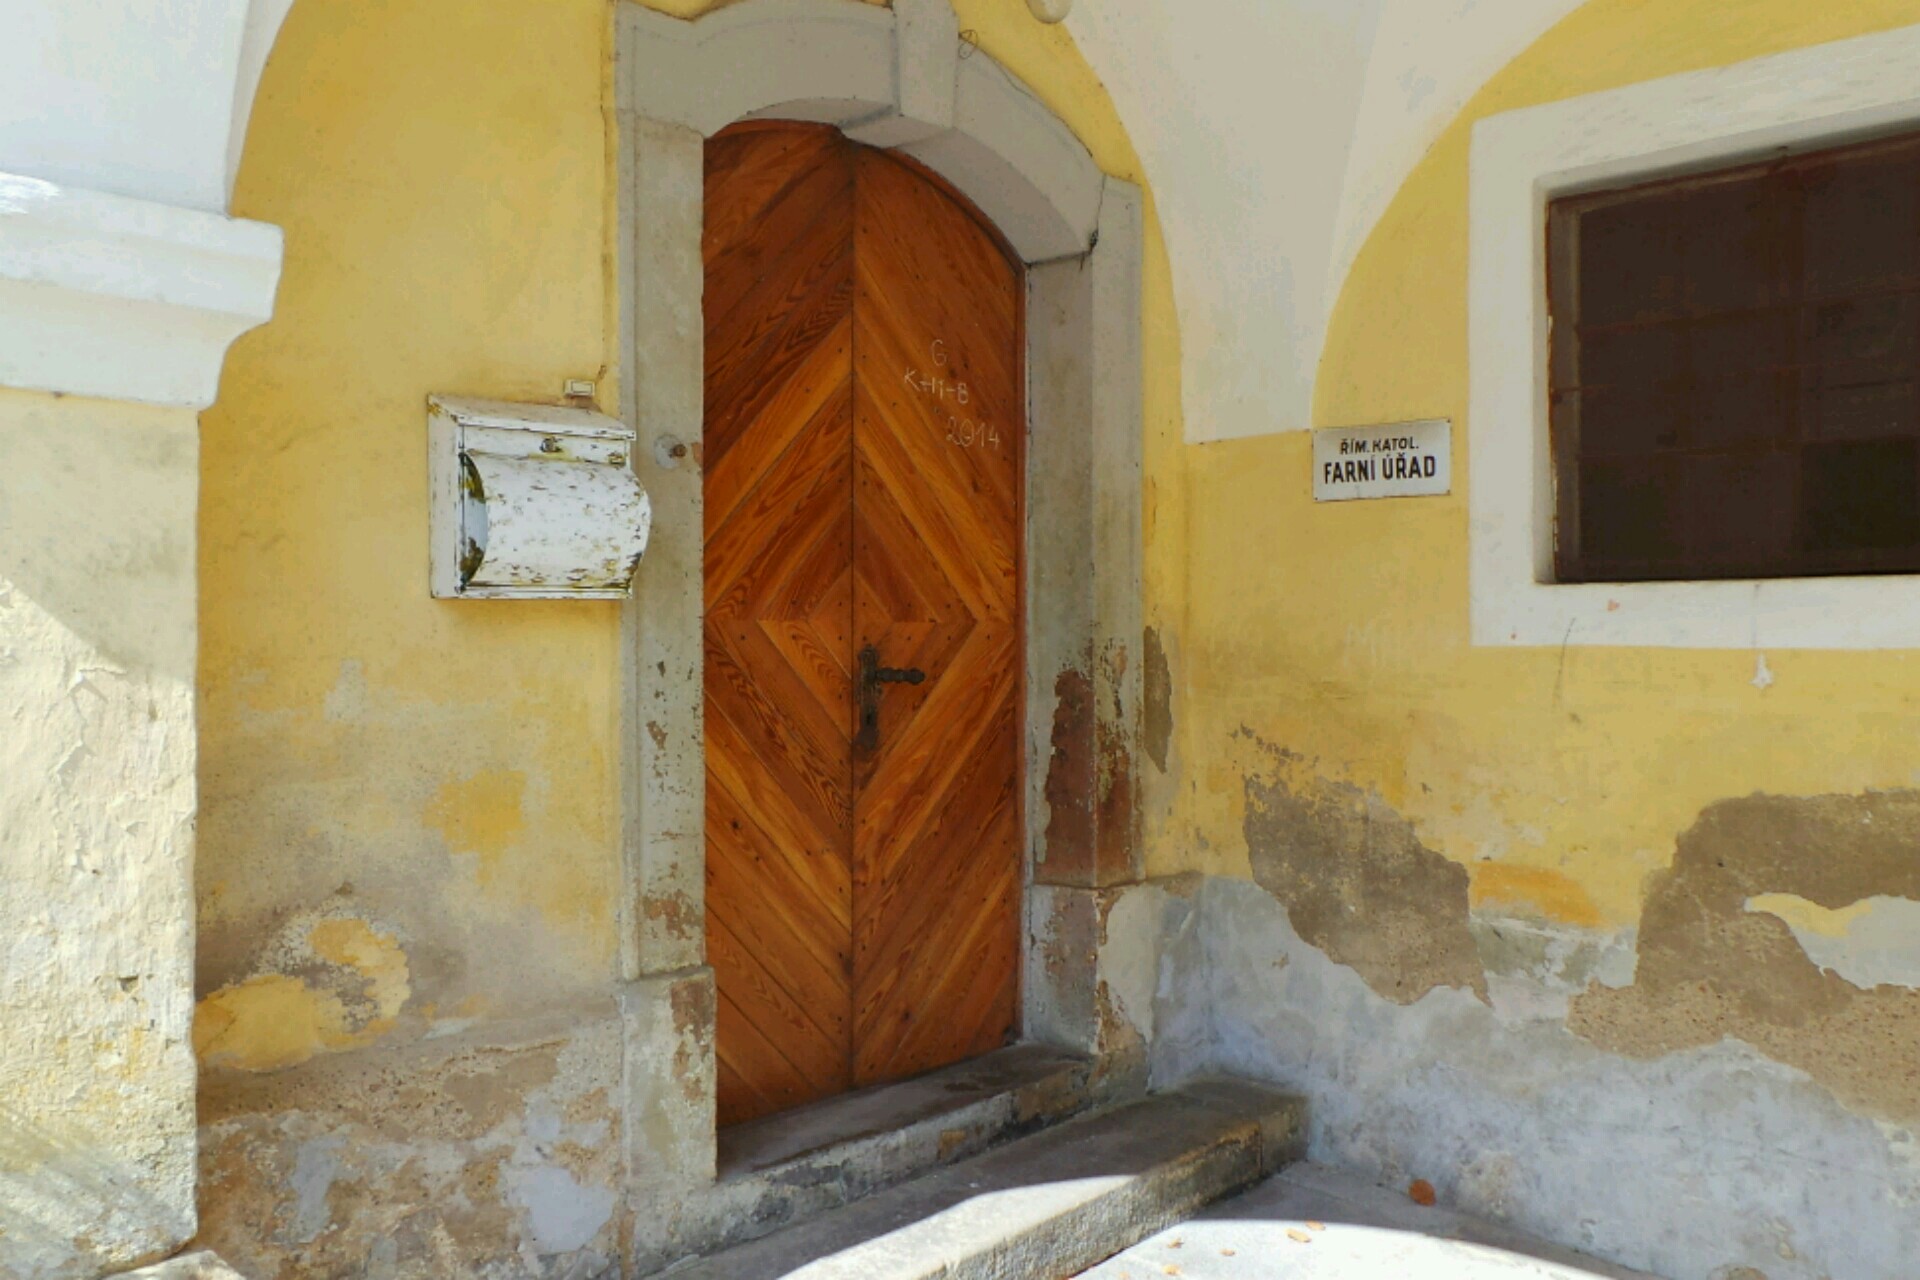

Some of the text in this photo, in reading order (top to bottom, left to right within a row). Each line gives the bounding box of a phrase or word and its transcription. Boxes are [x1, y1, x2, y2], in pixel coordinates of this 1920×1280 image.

[946, 416, 1001, 450] 2014
[1339, 436, 1419, 455] ŘÍM. KATOL.
[1324, 453, 1436, 485] FARNÍ ÚŘAD
